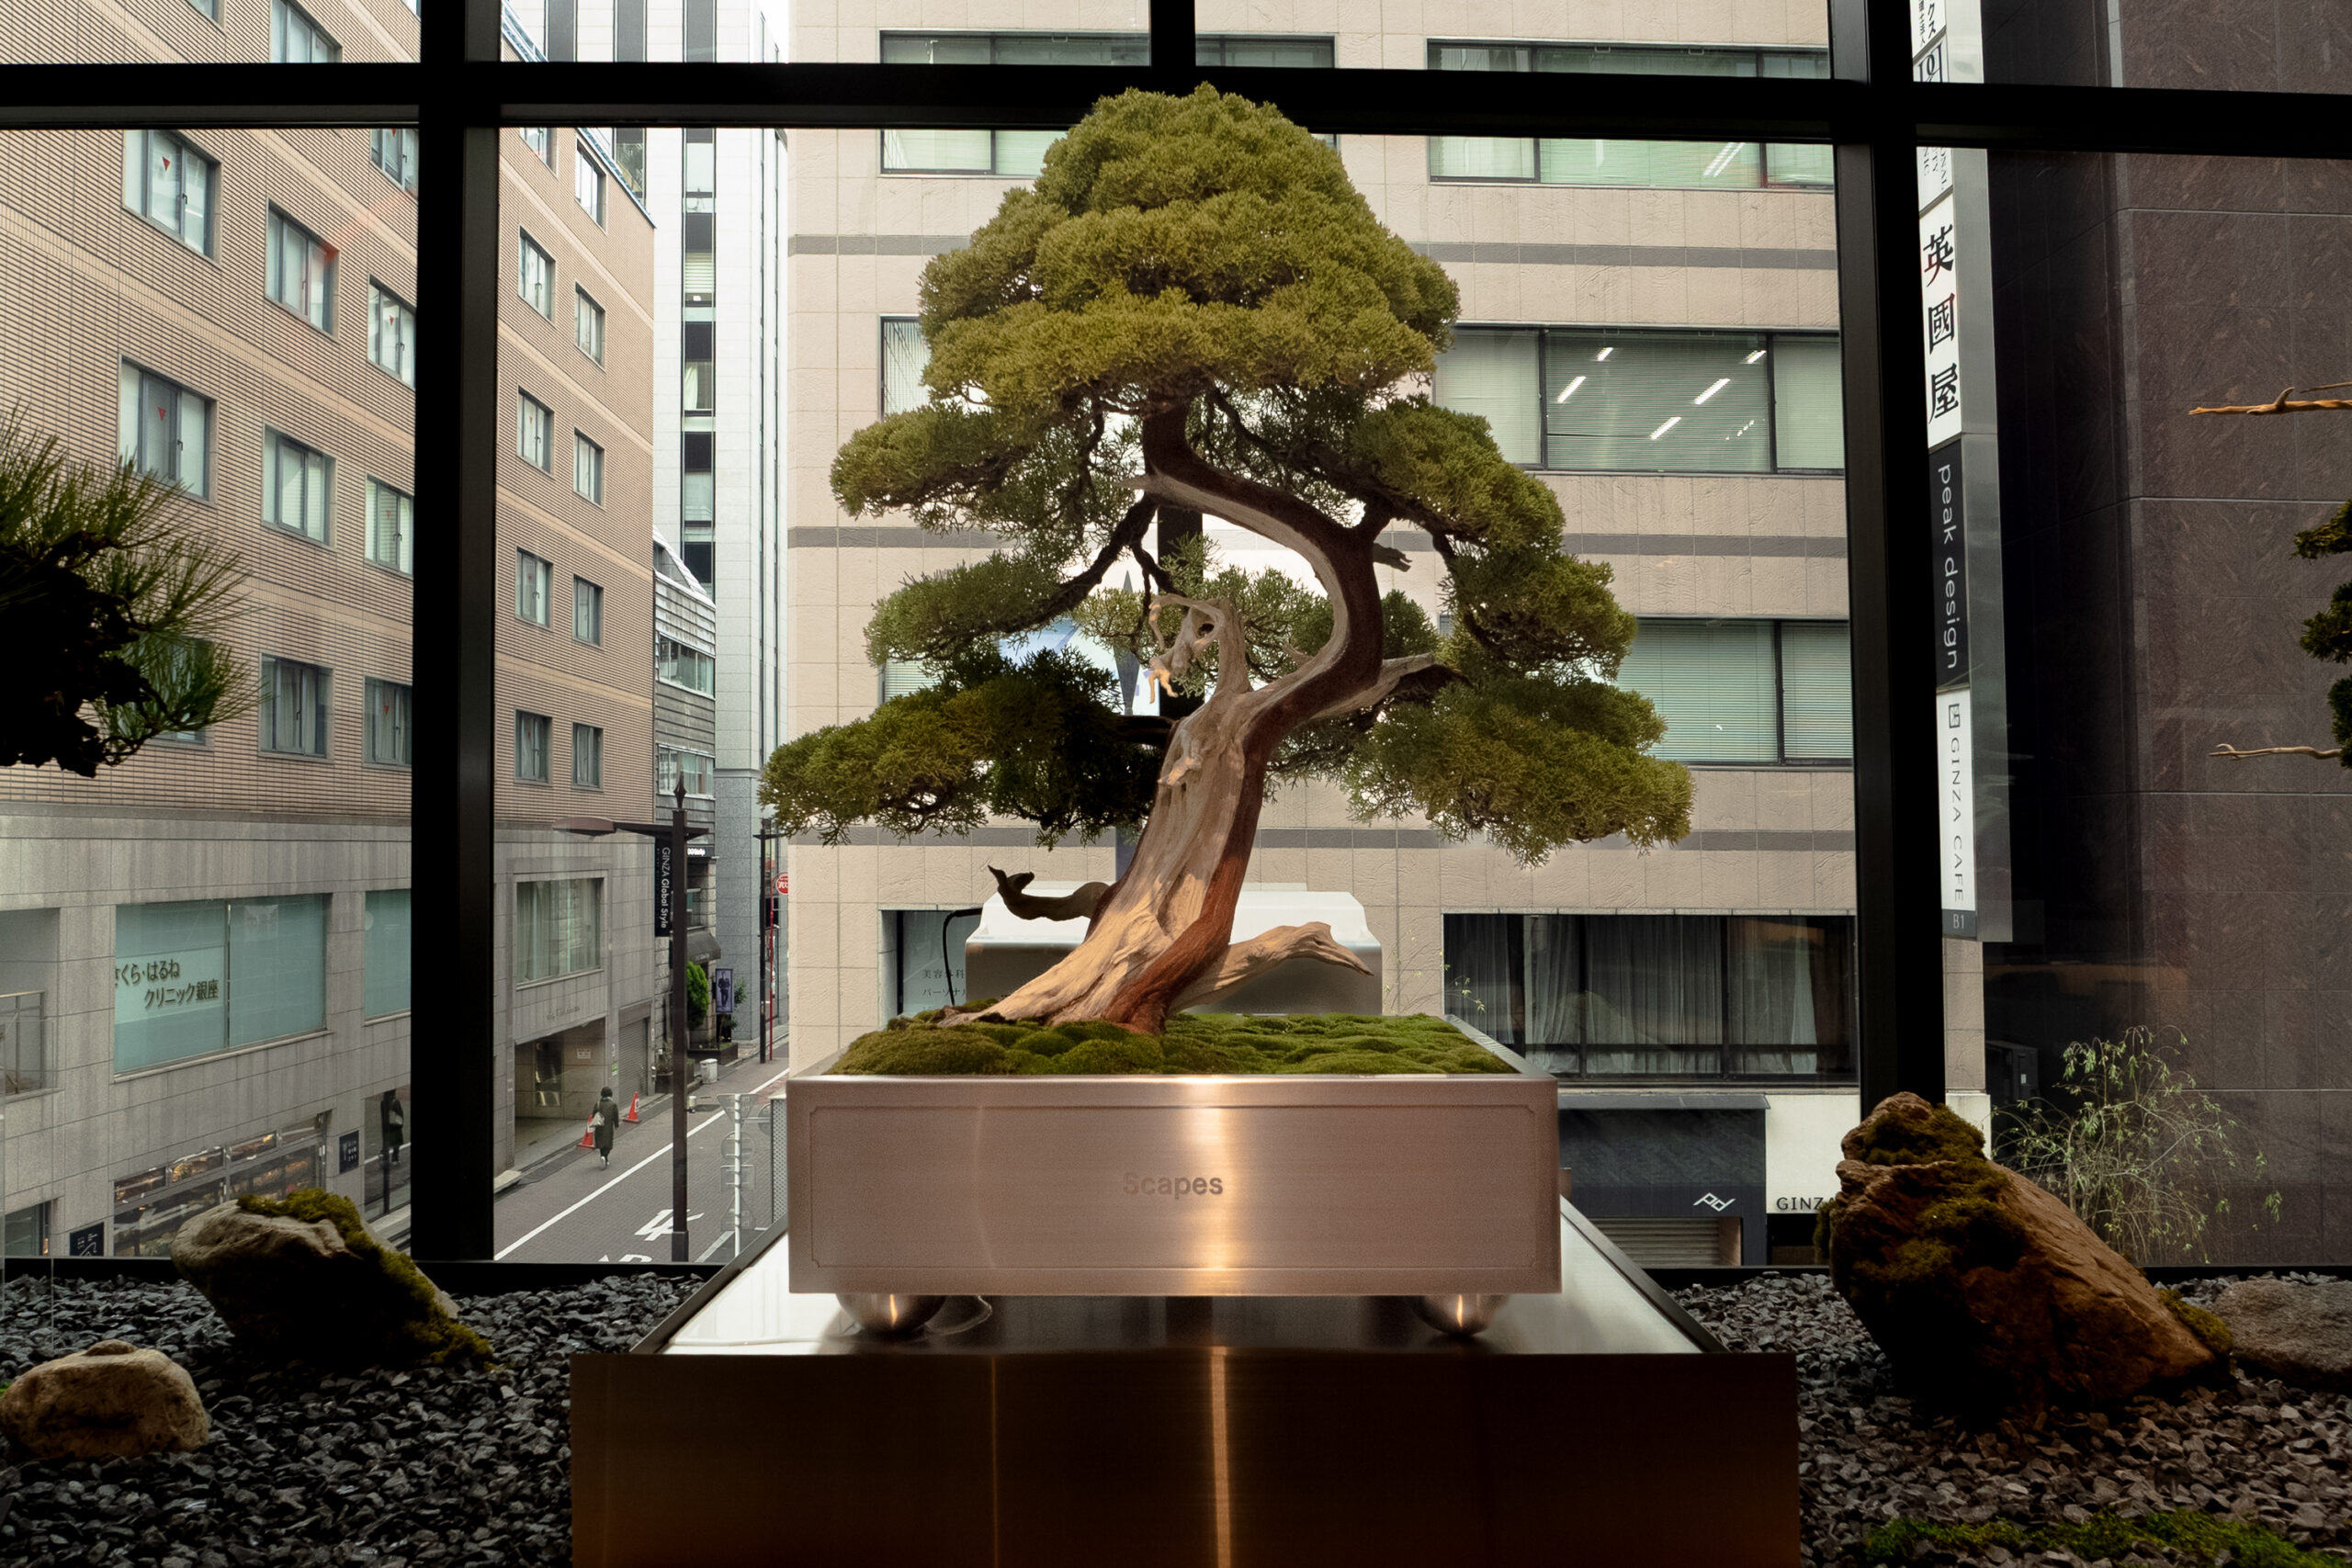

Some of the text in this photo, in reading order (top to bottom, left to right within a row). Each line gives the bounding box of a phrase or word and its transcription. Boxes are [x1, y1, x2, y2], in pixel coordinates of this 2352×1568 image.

[1923, 224, 1959, 424] 英國屋
[1938, 465, 1960, 669] peak design
[1951, 737, 1963, 902] GINZA CAFE
[659, 847, 671, 929] GINZA Global Style
[1952, 914, 1964, 930] B1
[143, 978, 219, 1009] クリニック銀座
[1123, 1172, 1224, 1200] Scapes
